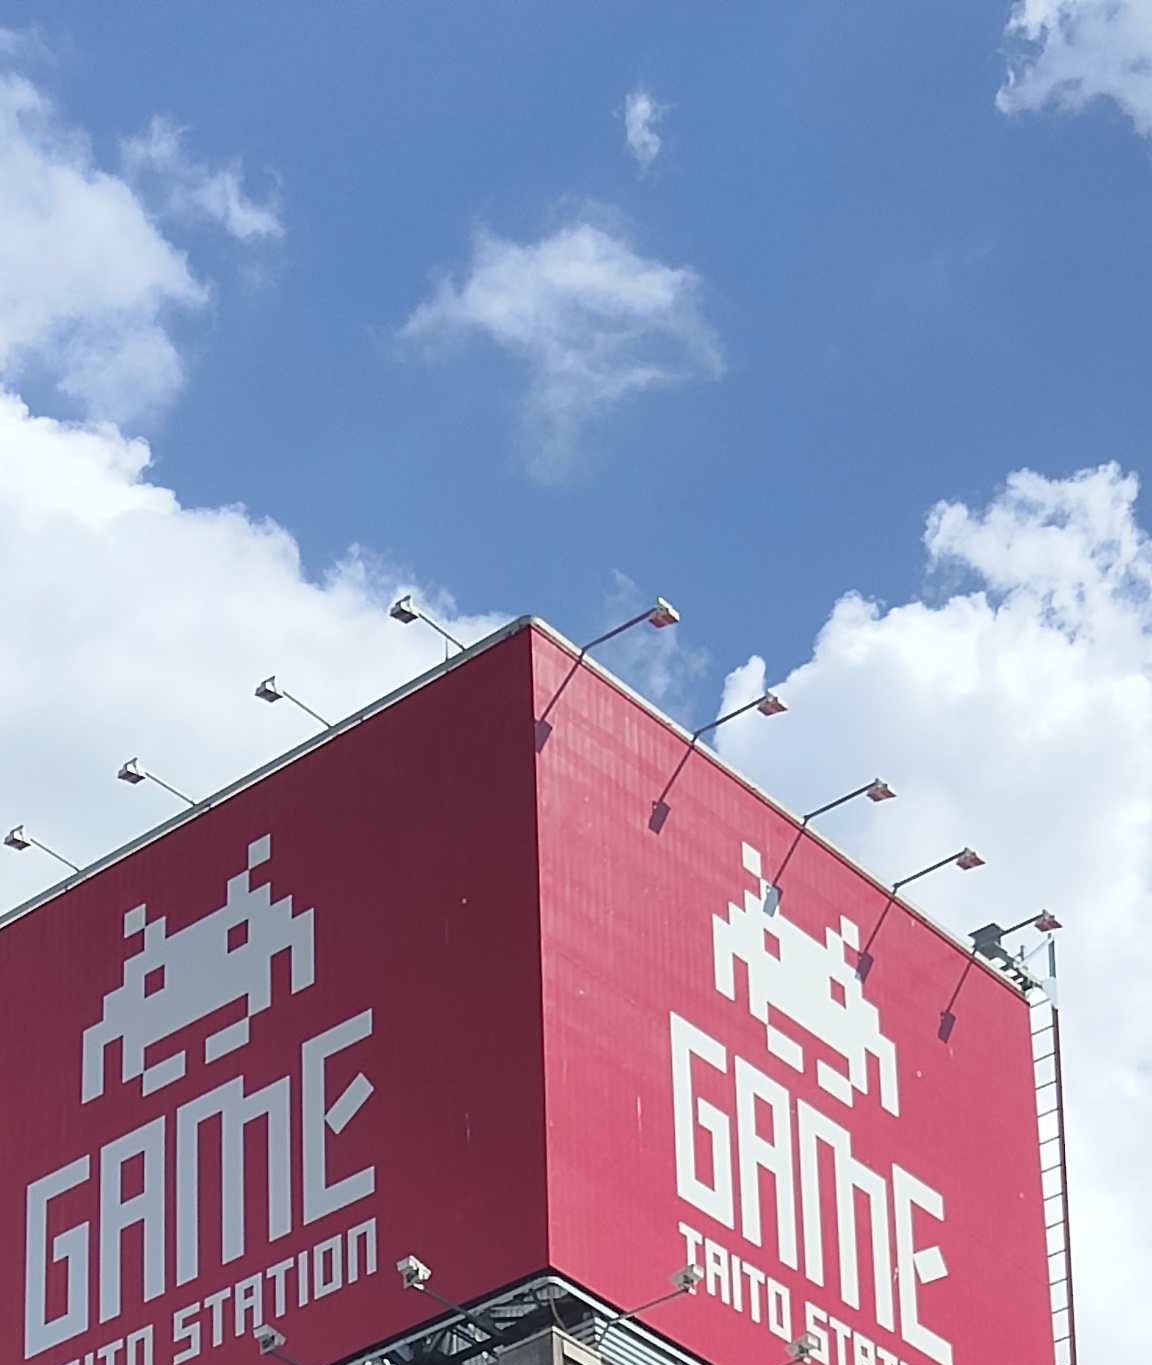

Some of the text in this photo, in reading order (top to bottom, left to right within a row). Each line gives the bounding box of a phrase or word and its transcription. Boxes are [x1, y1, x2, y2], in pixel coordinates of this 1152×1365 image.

[24, 1008, 375, 1359] GAME
[173, 1217, 377, 1365] STATION
[679, 1222, 792, 1344] TAITO
